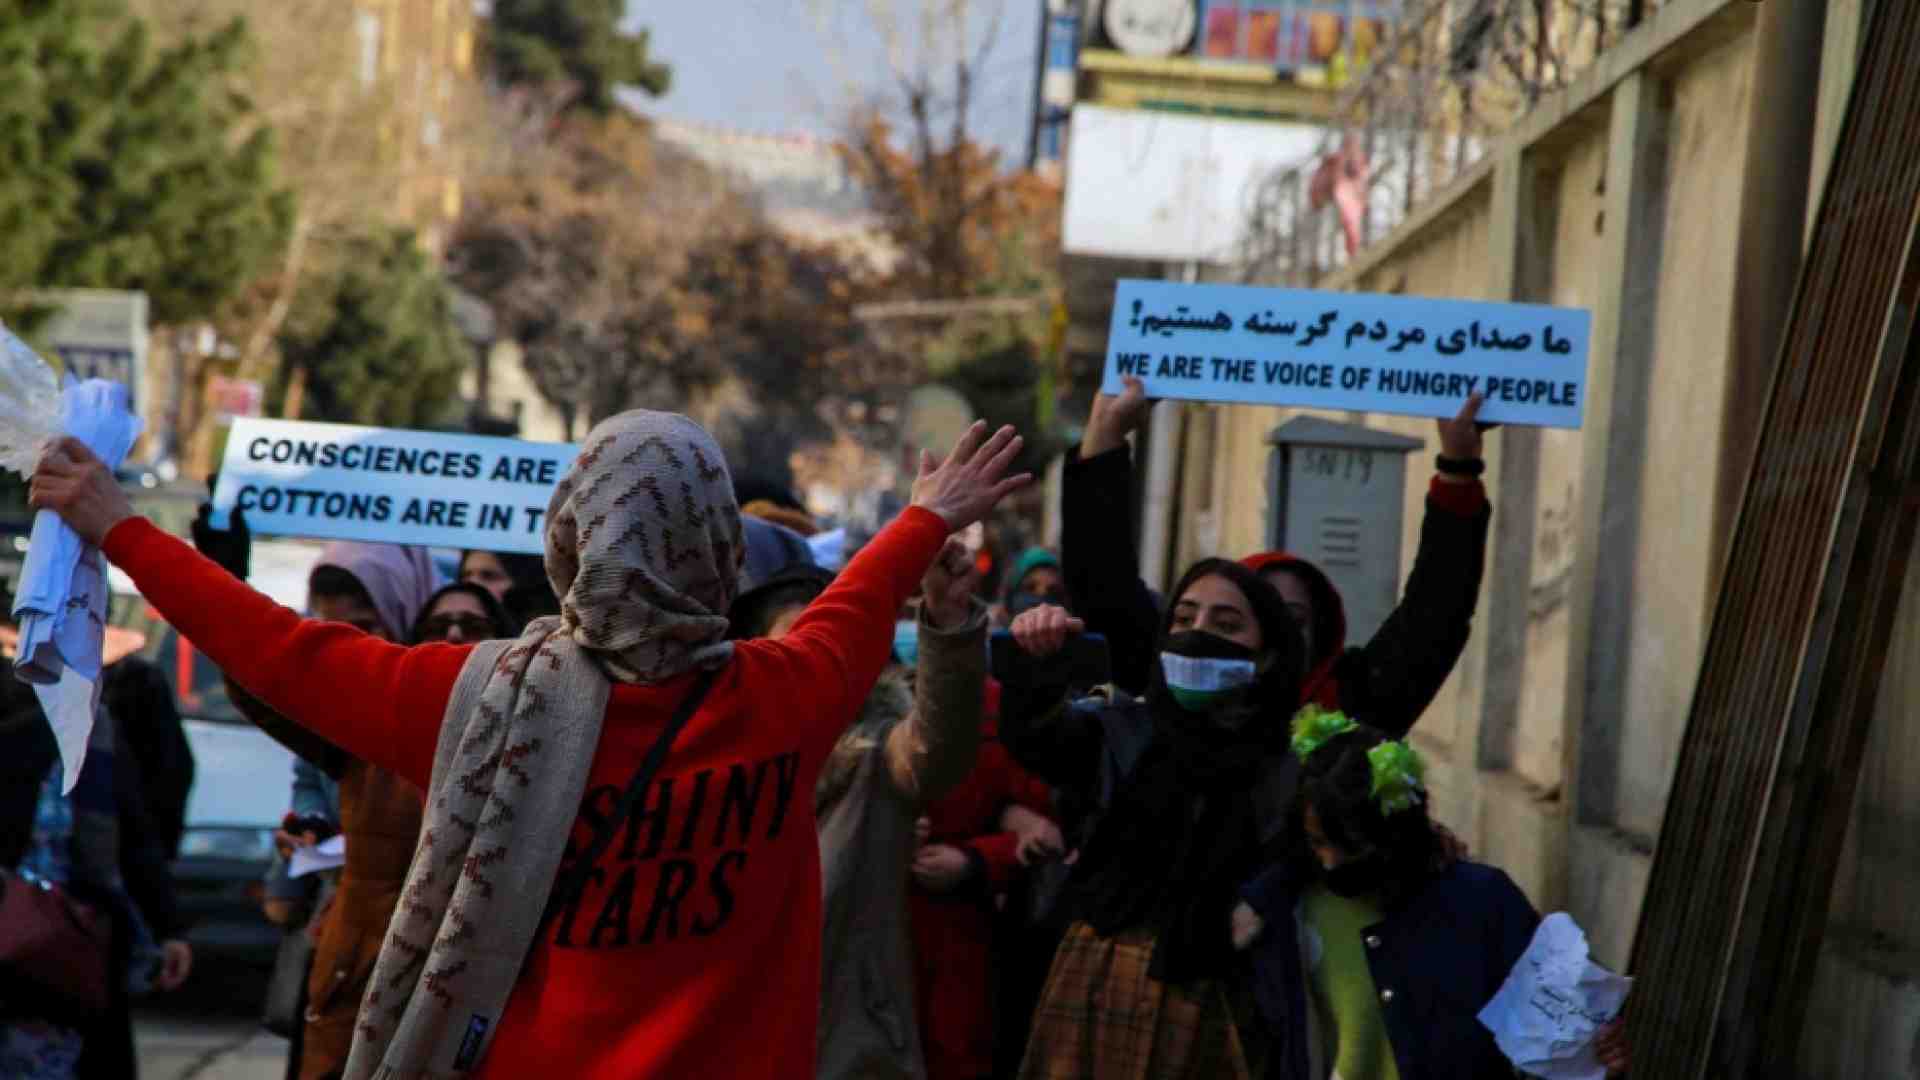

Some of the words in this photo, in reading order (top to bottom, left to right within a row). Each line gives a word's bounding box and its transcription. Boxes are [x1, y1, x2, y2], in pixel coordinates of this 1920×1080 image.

[1129, 299, 1232, 337] هستیم!
[1244, 309, 1338, 348] گرسنه
[1345, 318, 1426, 352] مردم
[1435, 319, 1532, 355] صدای
[1543, 324, 1571, 354] ما
[1116, 353, 1151, 376] WE
[1156, 355, 1203, 379] ARE
[1210, 357, 1256, 382] THE
[1263, 361, 1333, 388] VOICE
[1341, 366, 1371, 390] OF
[1377, 366, 1480, 398] HUNGRY
[1485, 375, 1578, 406] PEOPLE
[249, 437, 481, 479] CONSCIENCES
[490, 455, 558, 485] ARE
[237, 484, 393, 523] COTTONS
[399, 498, 469, 528] ARE
[477, 504, 513, 532] IN
[525, 505, 544, 534] T
[566, 751, 801, 861] SHINY
